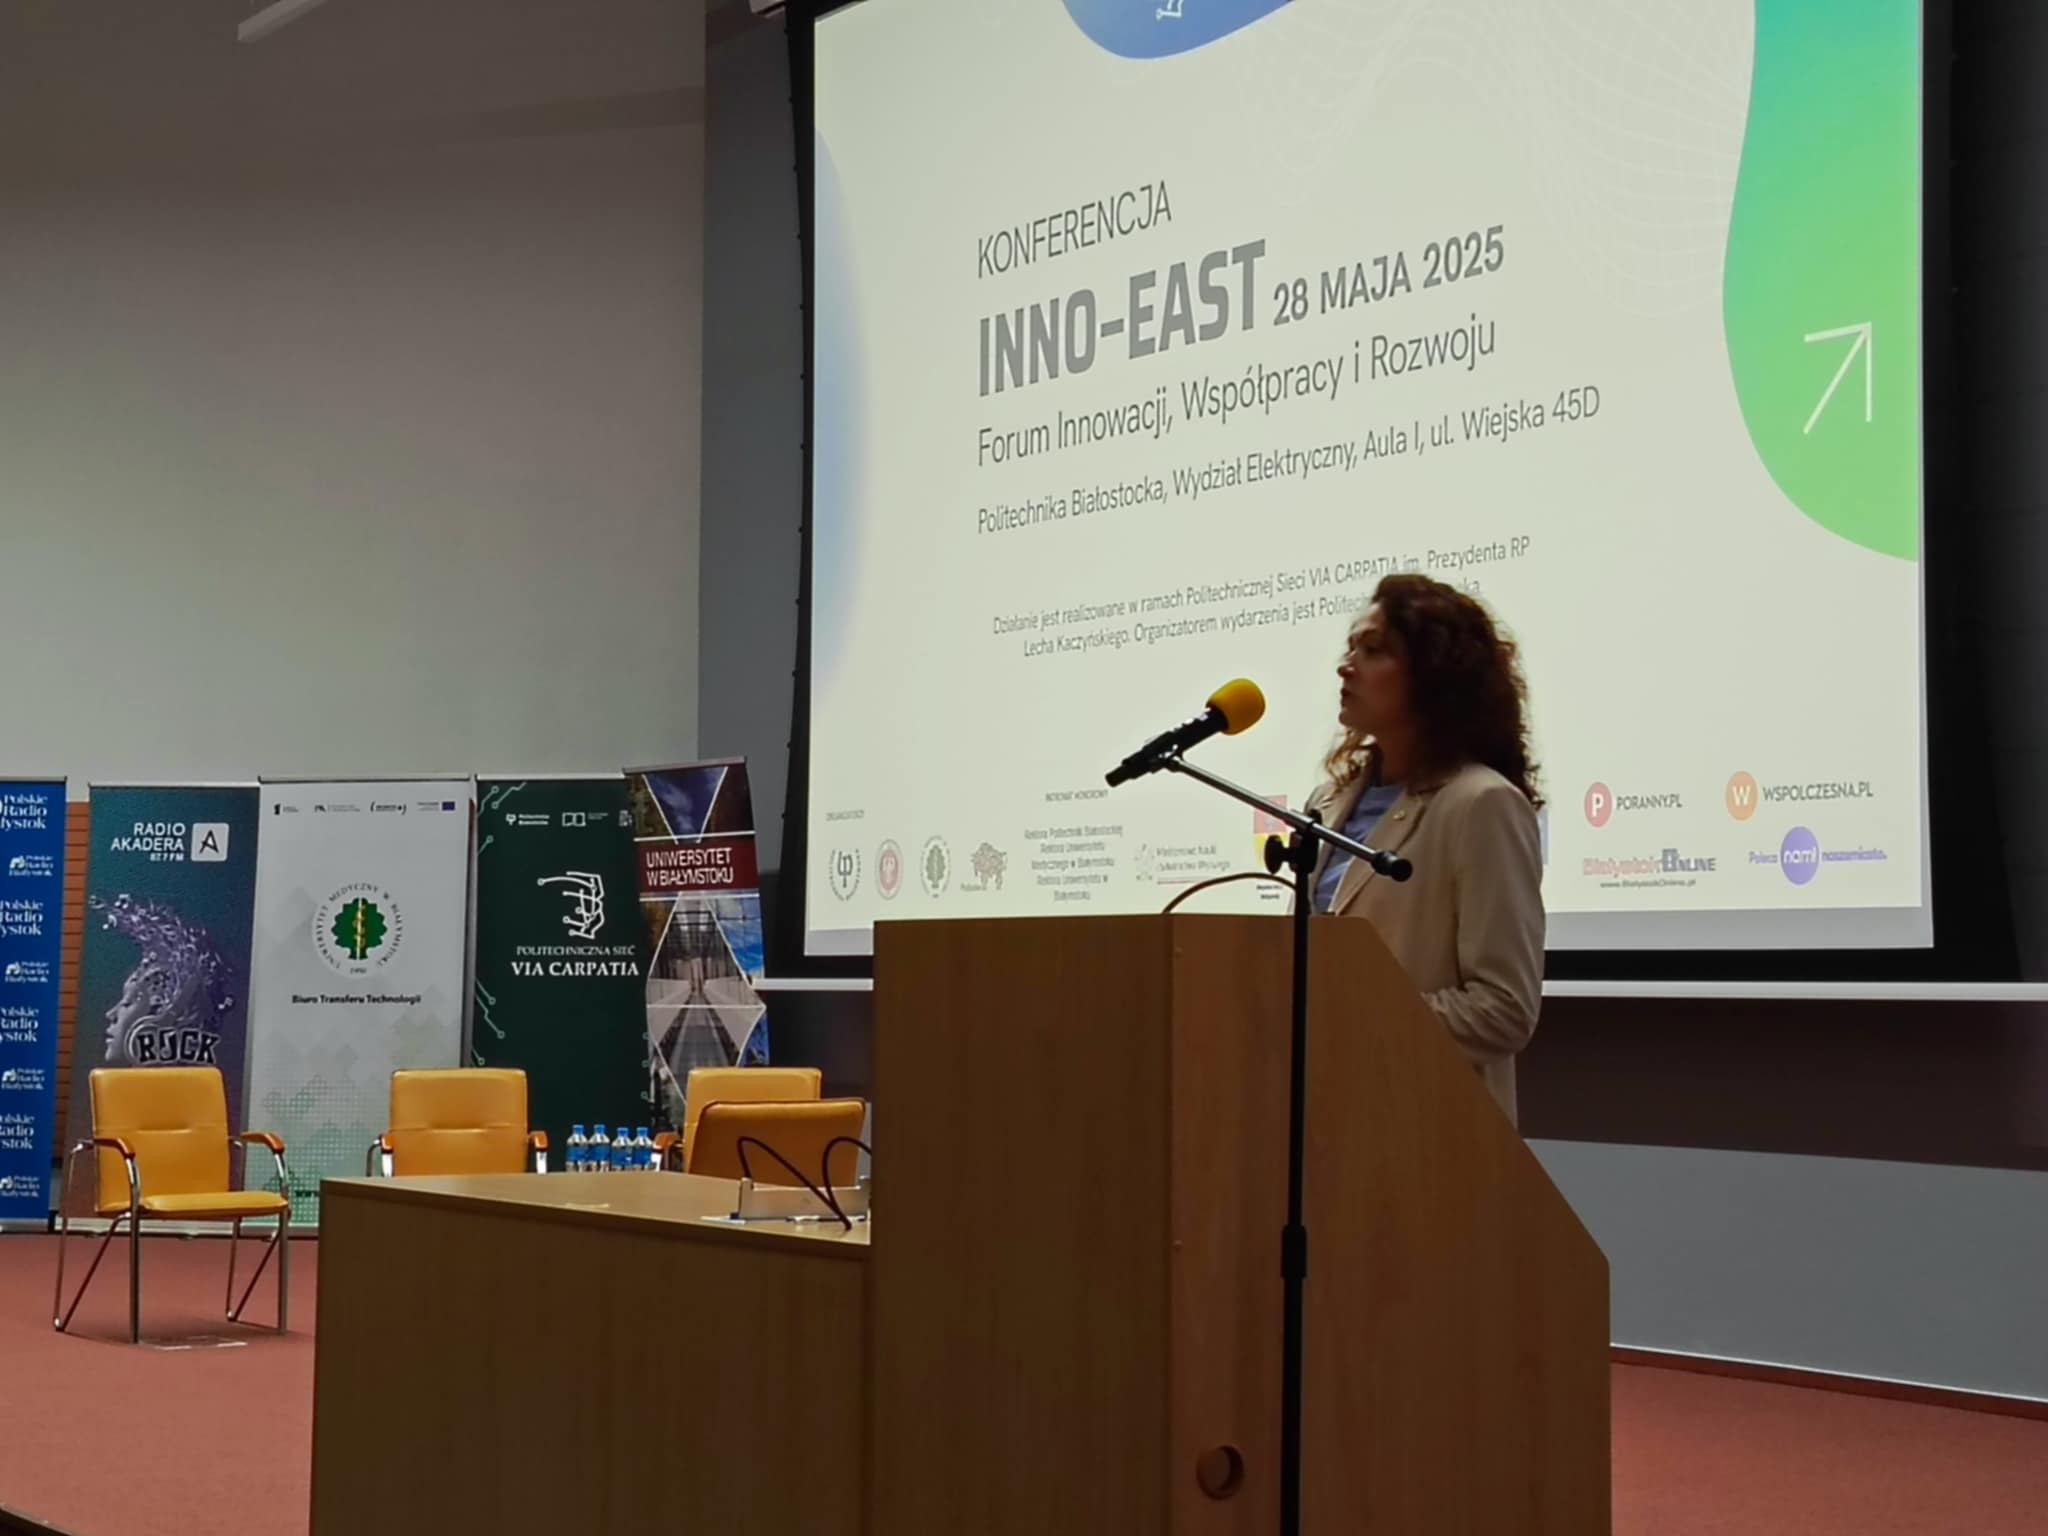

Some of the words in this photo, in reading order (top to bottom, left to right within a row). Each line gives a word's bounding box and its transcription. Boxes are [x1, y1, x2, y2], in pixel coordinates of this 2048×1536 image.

[978, 180, 1171, 279] KONFERENCJA
[979, 239, 1265, 397] INNO-EAST
[1273, 277, 1309, 326] 28
[1320, 251, 1412, 314] MAJA
[1422, 225, 1504, 288] 2025
[979, 423, 1050, 466] Forum
[1058, 386, 1172, 449] Innowacji,
[1181, 356, 1343, 424] Współpracy
[1354, 341, 1360, 383] i
[1371, 313, 1495, 380] Rozwoju
[978, 495, 1066, 534] Politechnika
[1072, 475, 1167, 516] Białostocka,
[1173, 456, 1242, 501] Wydział
[1247, 441, 1358, 483] Elektryczny,
[1363, 426, 1408, 460] Aula
[1414, 421, 1425, 456] I,
[1431, 415, 1454, 448] ul.
[1462, 399, 1545, 442] Wiejska
[1552, 386, 1600, 423] 45D
[993, 611, 1038, 634] Działanie
[1040, 610, 1060, 632] jest
[1062, 600, 1124, 624] realizowane
[1128, 601, 1138, 613] w
[1141, 589, 1183, 613] ramach
[1187, 575, 1274, 606] Politechnicznej
[1277, 569, 1306, 593] Sieci
[1309, 565, 1331, 587] VIA
[1335, 557, 1399, 583] CARPATIA
[1427, 541, 1506, 571] Prezydenta
[1511, 535, 1530, 559] RP
[1024, 637, 1053, 657] Lecha
[1134, 613, 1217, 644] Organizatorem
[1220, 604, 1289, 632] wydarzenia
[1292, 599, 1315, 625] jest
[1762, 780, 1874, 801] WSPOLCZESNA.PL
[134, 822, 186, 836] RADIO
[111, 837, 184, 851] AKADERA
[646, 847, 732, 868] UNIWERSYTET
[646, 870, 659, 887] W
[660, 866, 734, 886] BIAŁYMSTOKU
[516, 945, 611, 956] POLITECHNICZNA
[612, 944, 636, 956] SIEĆ
[511, 961, 544, 976] VIA
[548, 961, 640, 976] CARPATIA
[292, 994, 318, 1004] Biuro
[320, 994, 365, 1004] Transferu
[365, 994, 421, 1006] Technologii
